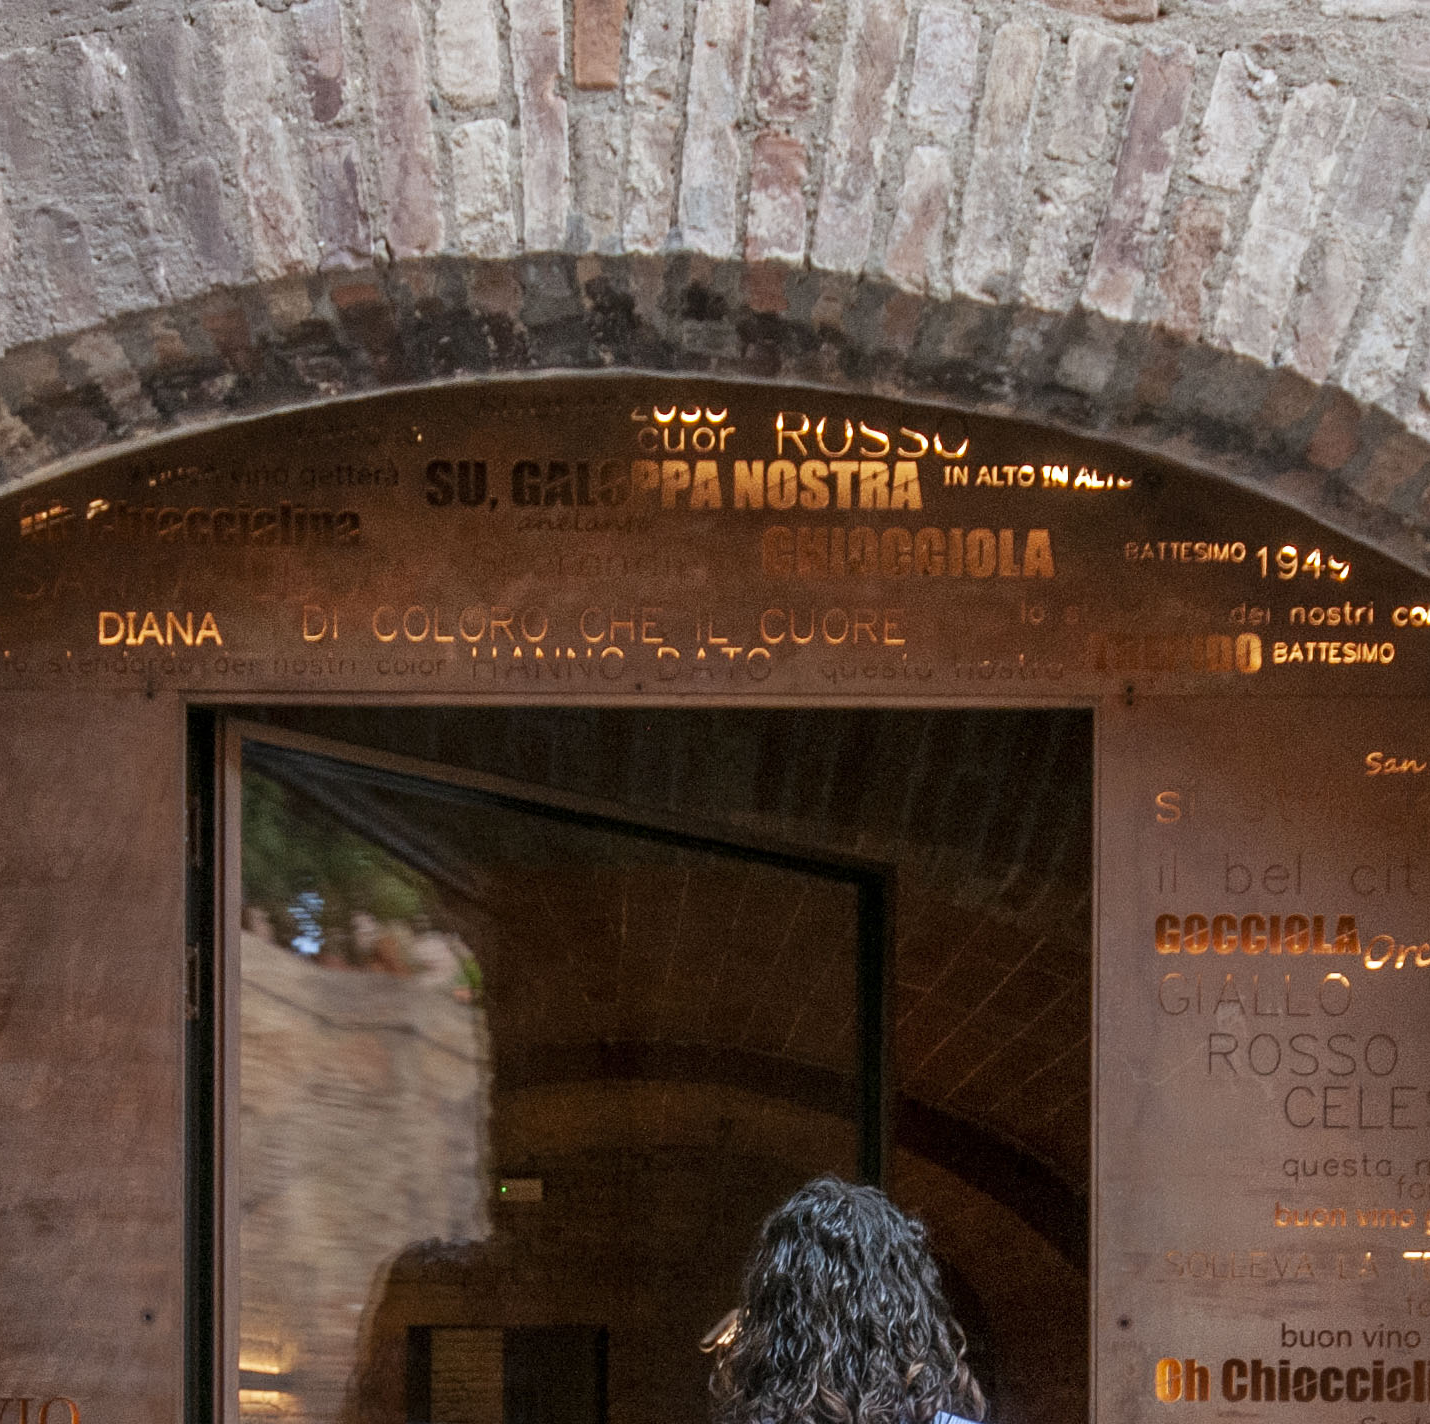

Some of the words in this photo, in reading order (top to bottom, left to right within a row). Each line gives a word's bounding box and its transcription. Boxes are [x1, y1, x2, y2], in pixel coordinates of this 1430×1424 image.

[425, 459, 499, 513] SU,
[511, 459, 723, 511] GALOPPA
[733, 458, 924, 511] NOSTRA
[942, 464, 970, 488] IN
[974, 464, 1037, 489] ALTO
[1124, 541, 1247, 565] BATTESIMO
[96, 610, 224, 648] DIANA
[371, 603, 550, 645] COLORO
[578, 606, 665, 646] CHE
[758, 606, 908, 649] CUORE
[1273, 641, 1395, 666] BATTESIMO
[1365, 750, 1428, 778] San
[1154, 912, 1362, 957] GOCCIOLA
[1157, 971, 1353, 1018] GIALLO
[1207, 1031, 1400, 1078] ROSSO
[1281, 1152, 1394, 1183] questa
[1280, 1322, 1353, 1350] buon
[1361, 1323, 1421, 1350] vino
[1154, 1357, 1211, 1404] Oh
